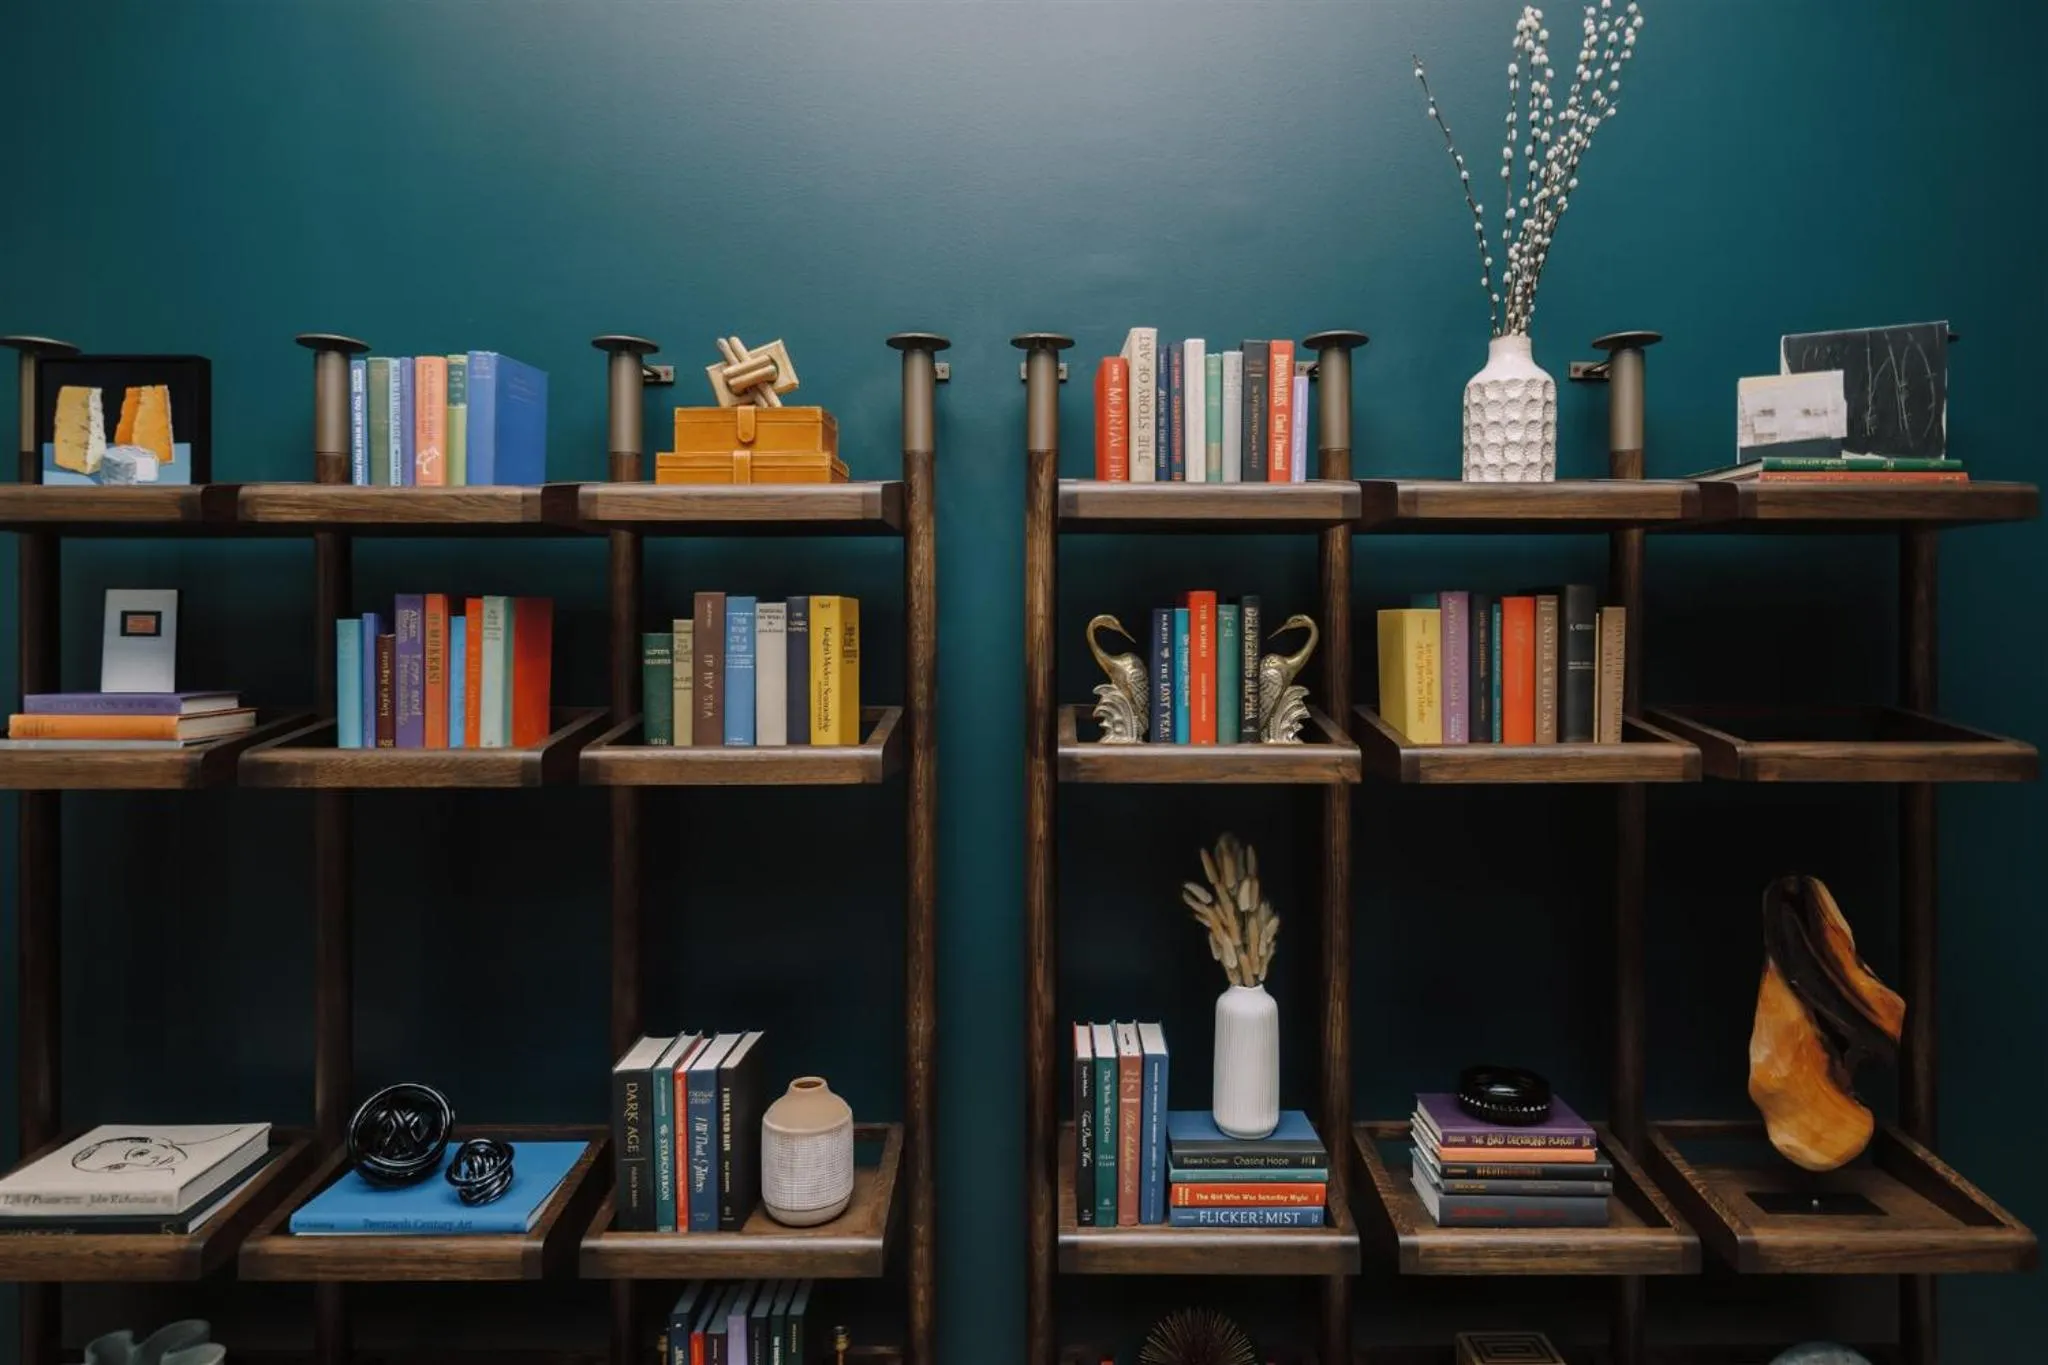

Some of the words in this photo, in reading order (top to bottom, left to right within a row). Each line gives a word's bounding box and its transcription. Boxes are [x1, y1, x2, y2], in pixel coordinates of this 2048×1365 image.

[1138, 335, 1151, 361] ART
[1138, 365, 1151, 384] OF
[1108, 387, 1123, 448] MORTAL
[1138, 386, 1151, 430] STORY
[1138, 435, 1151, 463] THE
[1244, 607, 1258, 677] DELIVERING
[822, 657, 832, 686] Modern
[1160, 682, 1171, 708] LOST
[1244, 679, 1258, 720] ALPHA
[1103, 1069, 1111, 1083] The
[625, 1082, 638, 1121] DARK
[1103, 1084, 1111, 1104] Whole
[1103, 1106, 1111, 1126] World
[626, 1126, 640, 1153] AGE
[1103, 1127, 1111, 1144] Over
[1472, 1135, 1484, 1145] THE
[1486, 1134, 1505, 1146] BAD
[1233, 1156, 1265, 1166] Chasing
[1266, 1156, 1289, 1166] Hope
[1196, 1193, 1208, 1201] The
[363, 1218, 411, 1231] Twentieth
[413, 1219, 453, 1232] Century
[455, 1219, 473, 1231] Art
[1199, 1211, 1258, 1224] FLICKER
[1266, 1212, 1301, 1224] MIST
